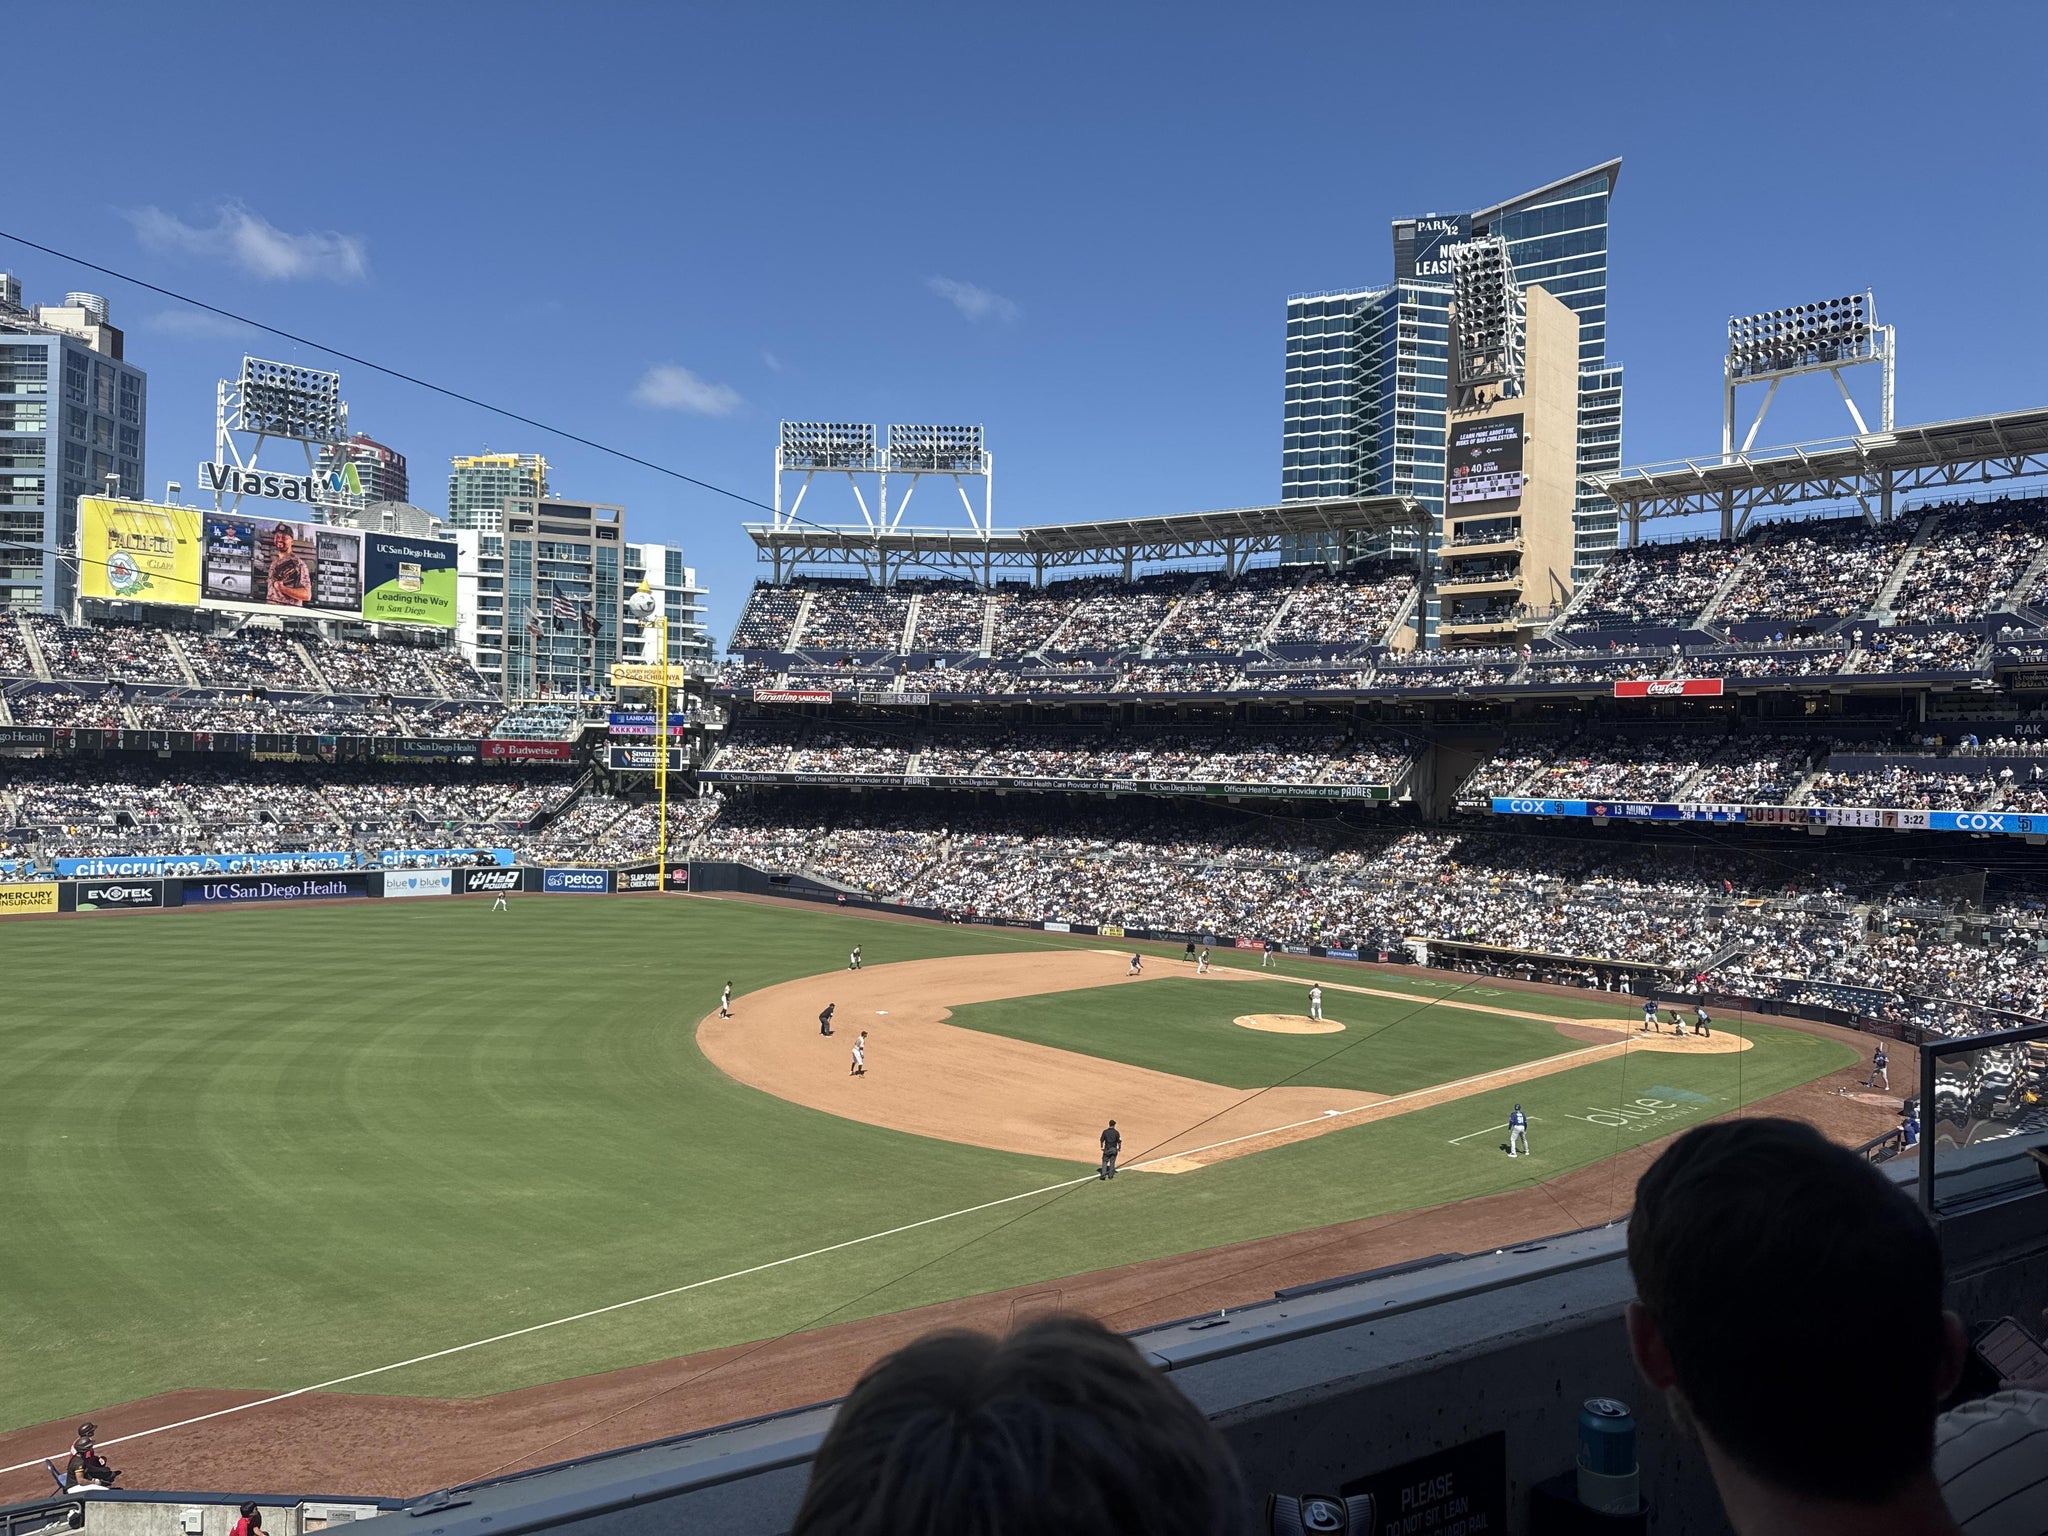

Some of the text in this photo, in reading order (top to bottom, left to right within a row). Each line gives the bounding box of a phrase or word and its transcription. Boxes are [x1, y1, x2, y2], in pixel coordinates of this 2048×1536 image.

[1417, 219, 1458, 235] PARK 12
[1471, 464, 1482, 473] 40
[207, 462, 318, 502] Viasat
[377, 544, 445, 559] UC San Diego Health
[377, 592, 448, 607] Leading the Way
[387, 604, 402, 613] San
[404, 606, 426, 616] Diego
[756, 692, 797, 701] Tarantino
[70, 730, 76, 738] 4
[118, 730, 124, 739] 6
[2015, 725, 2041, 734] RAK
[12, 731, 46, 742] Health
[69, 739, 76, 748] 9
[118, 740, 124, 749] 4
[163, 741, 170, 750] 5
[208, 741, 214, 751] 4
[403, 742, 477, 753] UC San Diego Health
[508, 745, 559, 755] Budweiser
[904, 777, 929, 786] PADRES
[1053, 780, 1066, 788] Care
[1067, 780, 1091, 788] Provider
[1112, 781, 1137, 791] PADRES
[1160, 783, 1170, 791] San
[1171, 784, 1187, 792] Diego
[1224, 785, 1371, 798] Official Health Care Provider of the PADRES
[1511, 801, 1545, 813] COX
[1614, 804, 1652, 816] 13 MUNCY
[1680, 812, 1695, 820] .264
[1727, 813, 1736, 821] 35
[1799, 809, 1807, 823] 2
[1846, 813, 1850, 821] H
[1865, 814, 1869, 822] E
[1875, 810, 1879, 818] 0
[1886, 815, 1893, 826] 7
[1904, 815, 1924, 825] 3:22
[1956, 814, 2004, 830] COX
[386, 877, 440, 887] blue blue
[485, 871, 520, 883] H2O
[565, 873, 603, 887] petco
[0, 891, 52, 899] MERCURY
[203, 880, 347, 899] UC San Diego Health
[1564, 1098, 1677, 1126] blue
[1402, 1472, 1453, 1512] PLEASE
[1402, 1511, 1424, 1536] NOT
[1444, 1495, 1468, 1520] LEAN
[1468, 1512, 1489, 1534] RAIL
